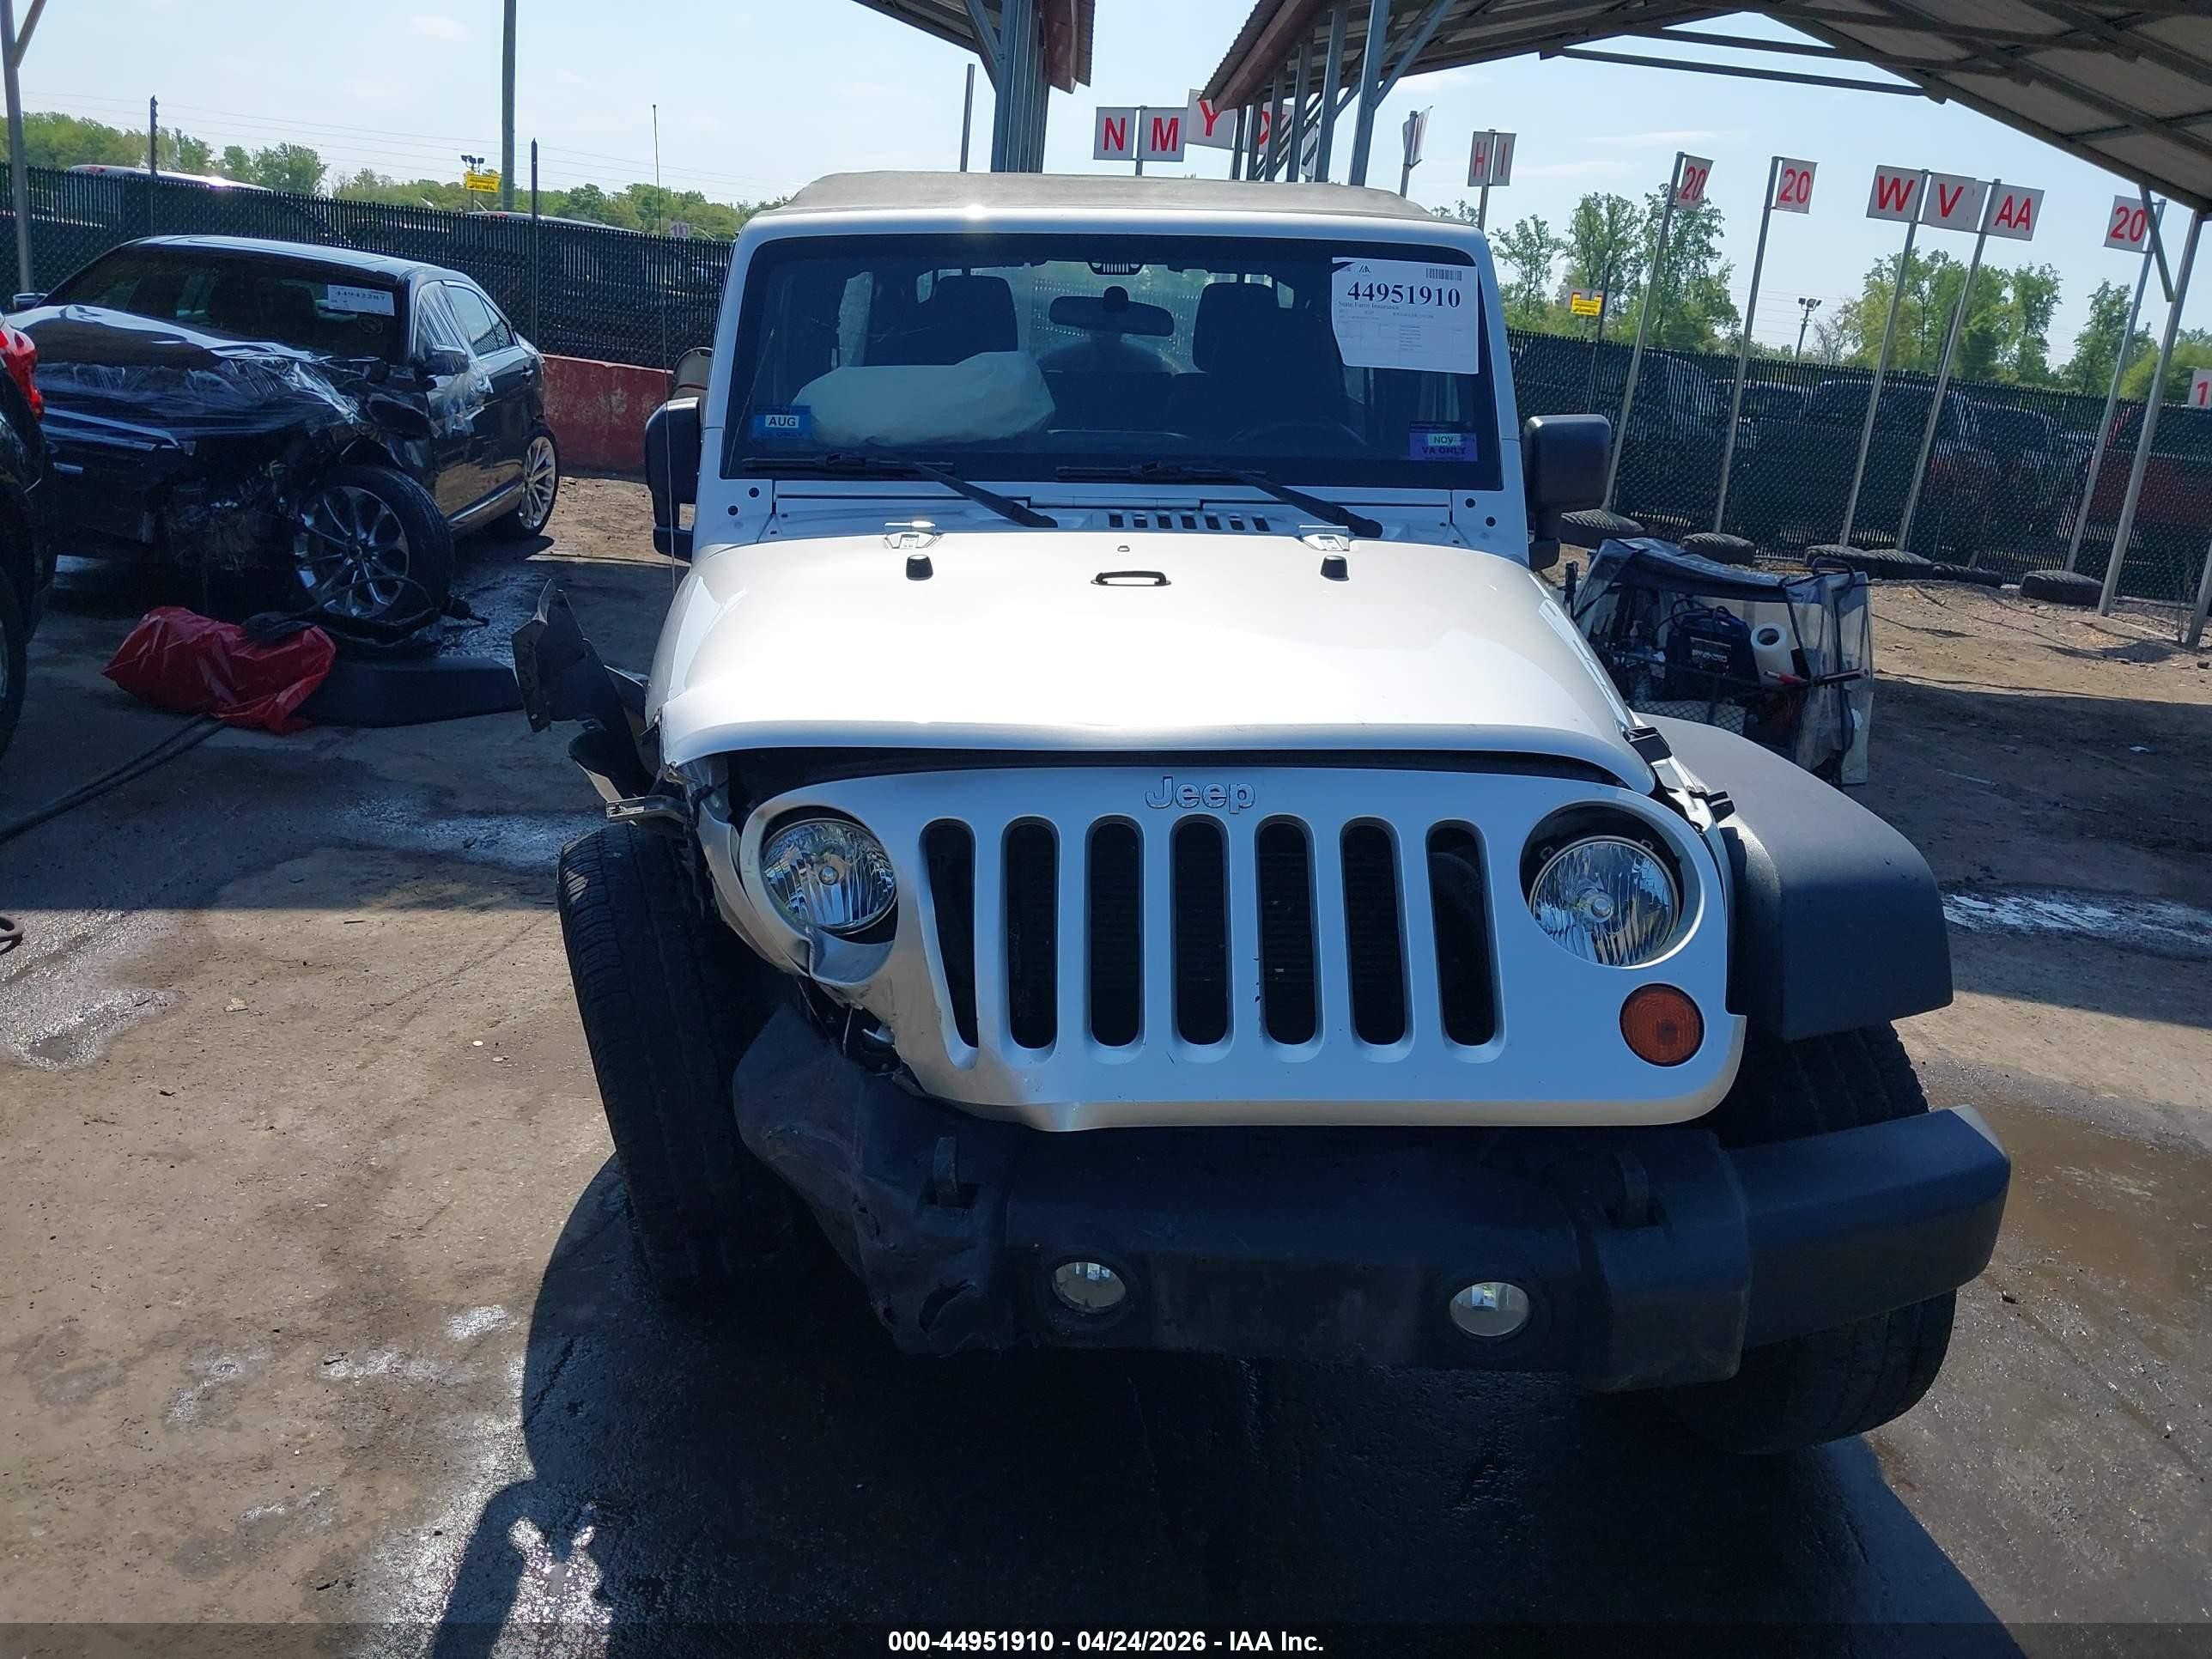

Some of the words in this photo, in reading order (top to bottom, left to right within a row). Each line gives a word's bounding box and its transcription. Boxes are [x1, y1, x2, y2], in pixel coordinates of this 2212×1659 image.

[1103, 117, 1126, 151] N
[1152, 117, 1179, 152] M
[1199, 100, 1224, 137] Y
[1474, 142, 1487, 177] H
[1681, 166, 1708, 201] 20
[1779, 168, 1811, 204] 20
[1878, 175, 1915, 212] W
[1939, 183, 1964, 218] V
[1994, 195, 2032, 231] AA
[2110, 206, 2147, 242] 20
[1347, 281, 1461, 308] 44951910
[769, 416, 796, 427] AUG
[1434, 435, 1454, 444] NOV
[1146, 775, 1255, 814] Jeep
